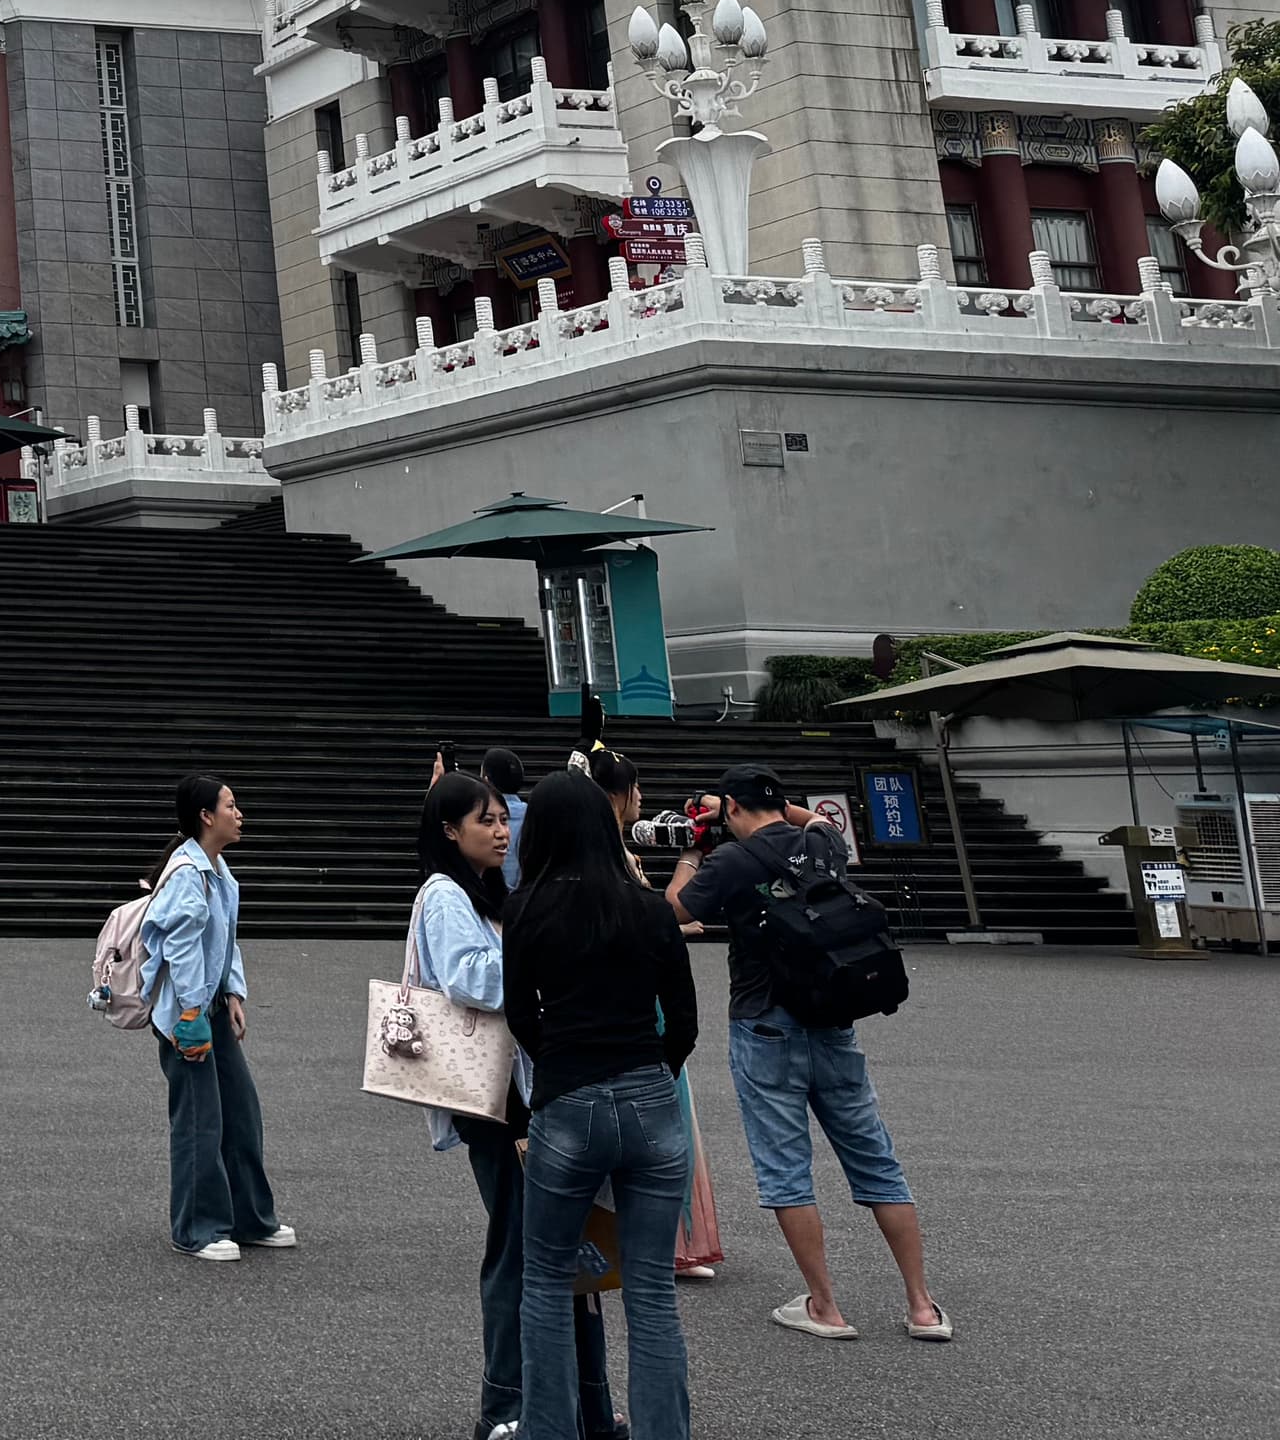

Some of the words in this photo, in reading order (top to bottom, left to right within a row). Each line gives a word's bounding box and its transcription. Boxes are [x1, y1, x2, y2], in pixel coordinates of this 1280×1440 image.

[663, 223, 689, 236] 重庆
[873, 776, 905, 792] 团队
[882, 794, 905, 838] 预约处
